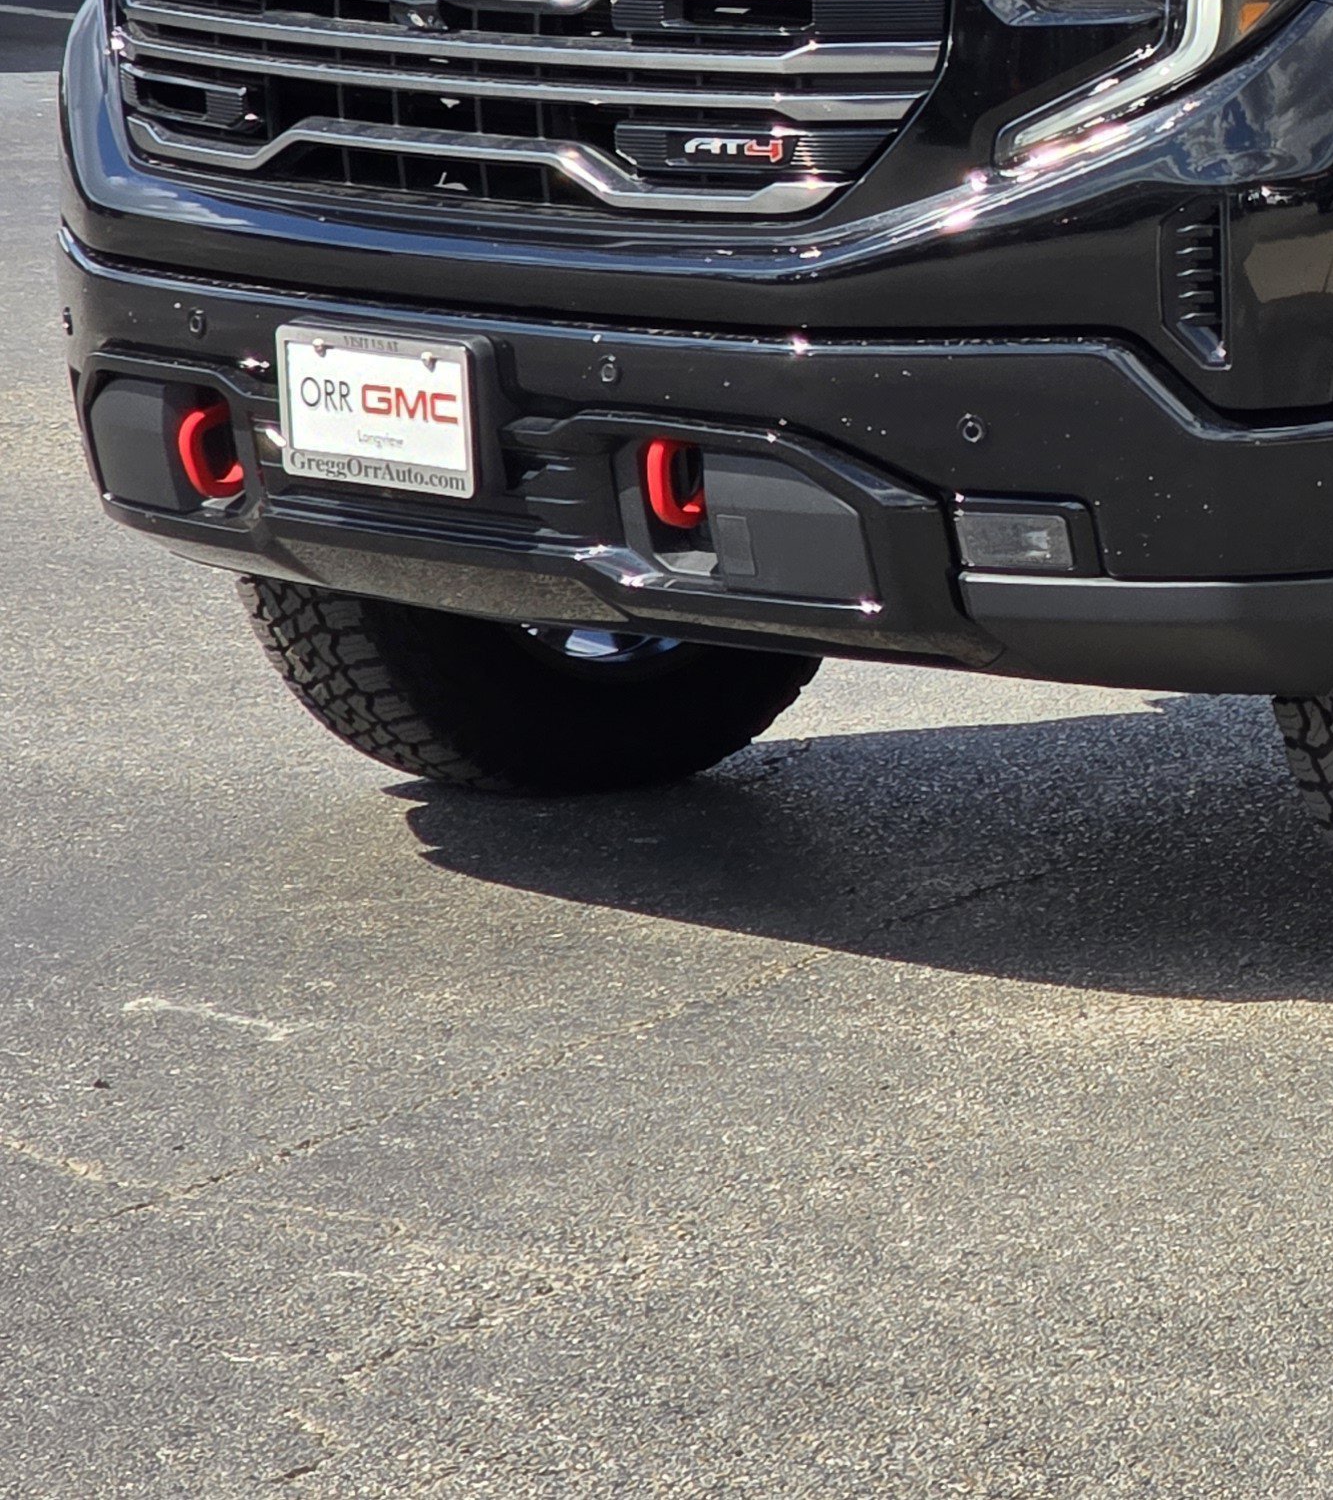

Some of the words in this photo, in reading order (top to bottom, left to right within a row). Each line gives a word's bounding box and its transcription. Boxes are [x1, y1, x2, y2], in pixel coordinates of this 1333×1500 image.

[684, 137, 783, 162] AT4
[300, 376, 353, 413] ORR
[361, 384, 459, 425] GMC
[290, 451, 467, 492] GreggOrrAuto.com
